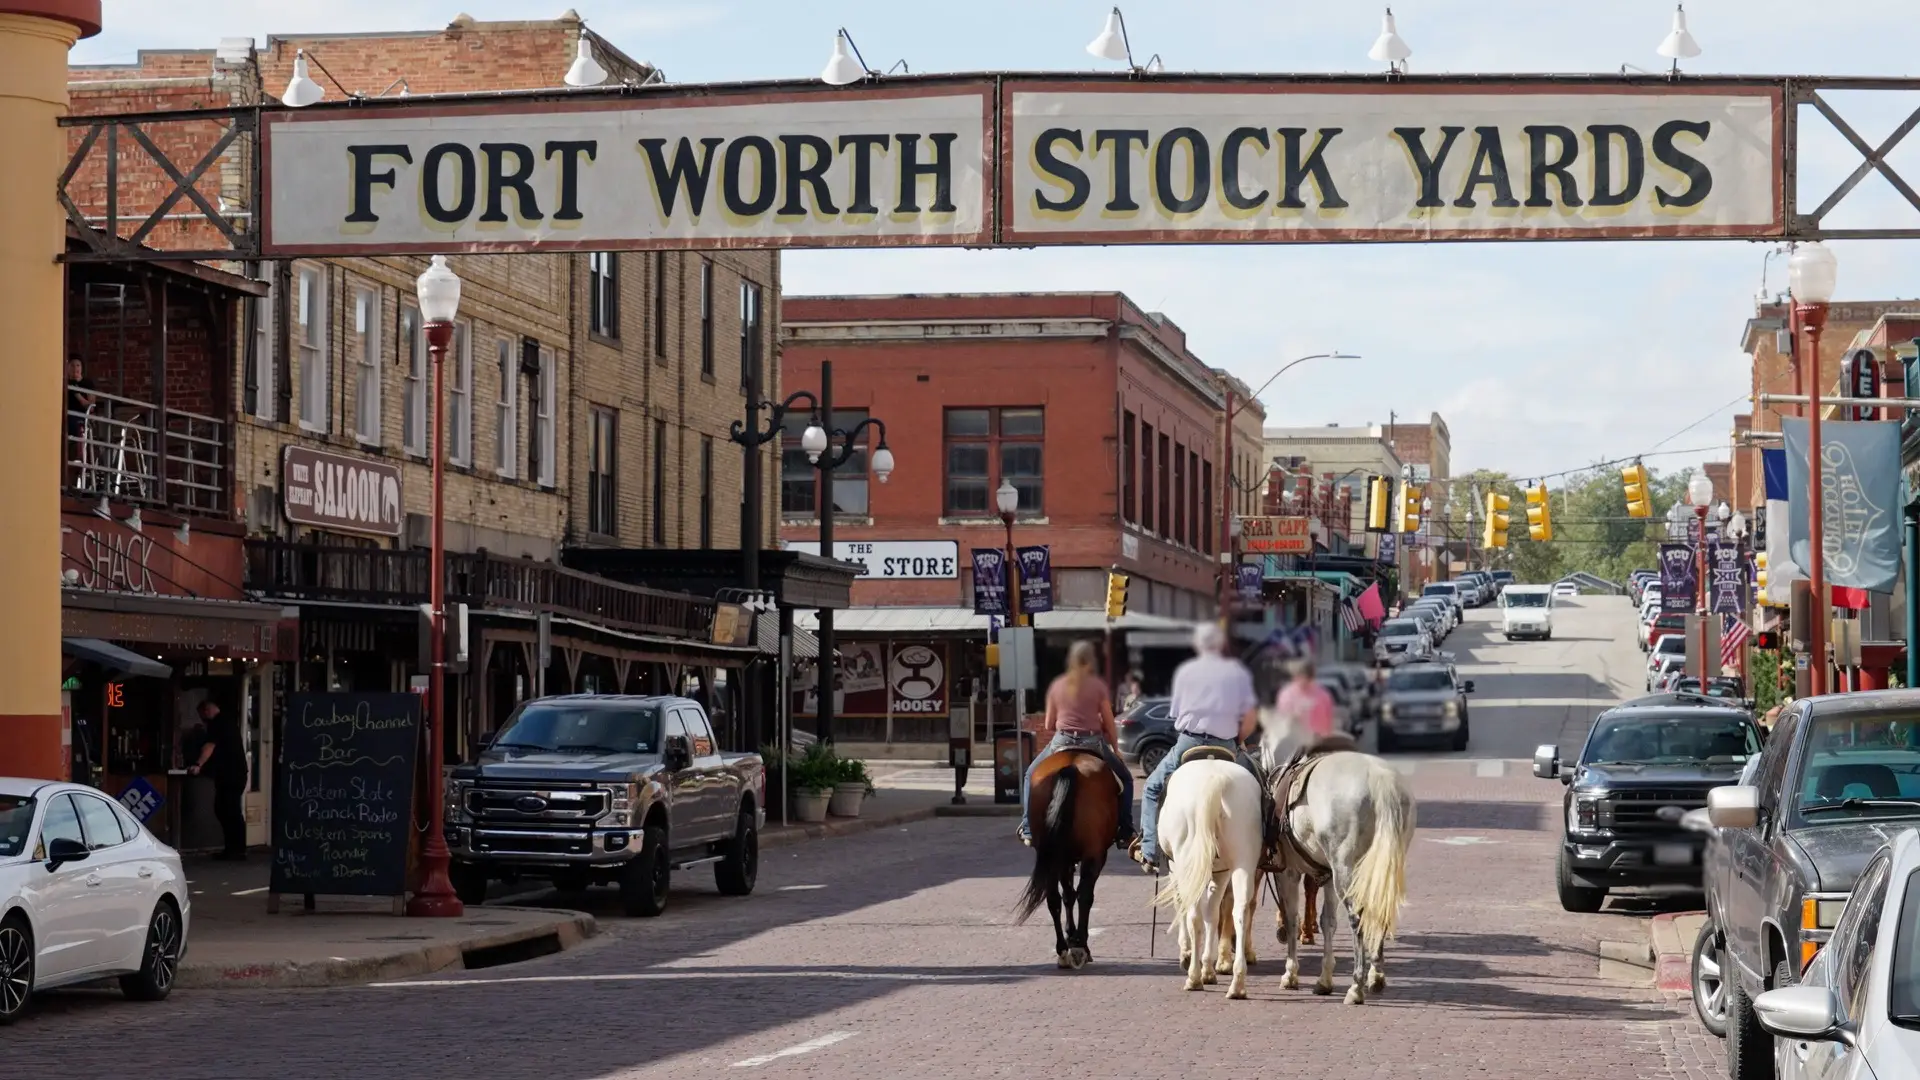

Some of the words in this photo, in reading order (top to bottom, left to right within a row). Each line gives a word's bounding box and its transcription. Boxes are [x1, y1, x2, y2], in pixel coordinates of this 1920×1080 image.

[342, 139, 598, 226] FORT
[638, 132, 958, 223] WORTH
[1033, 125, 1349, 216] STOCK
[1392, 119, 1714, 212] YARDS
[314, 460, 380, 523] SALOON
[1243, 520, 1273, 536] STAR
[1279, 520, 1309, 536] CAFE
[849, 544, 872, 554] THE
[1022, 550, 1043, 563] TCU
[1666, 549, 1690, 561] TCU
[1714, 549, 1738, 560] TCU
[82, 529, 157, 593] SHACK
[884, 557, 953, 576] STORE
[976, 553, 999, 565] TCU
[892, 700, 943, 712] HOOEY
[302, 701, 355, 741] Cowboy
[356, 701, 414, 730] Channel
[313, 733, 357, 761] Bar
[289, 773, 347, 800] Western
[301, 799, 355, 820] Ranch
[356, 803, 398, 822] Rodeo
